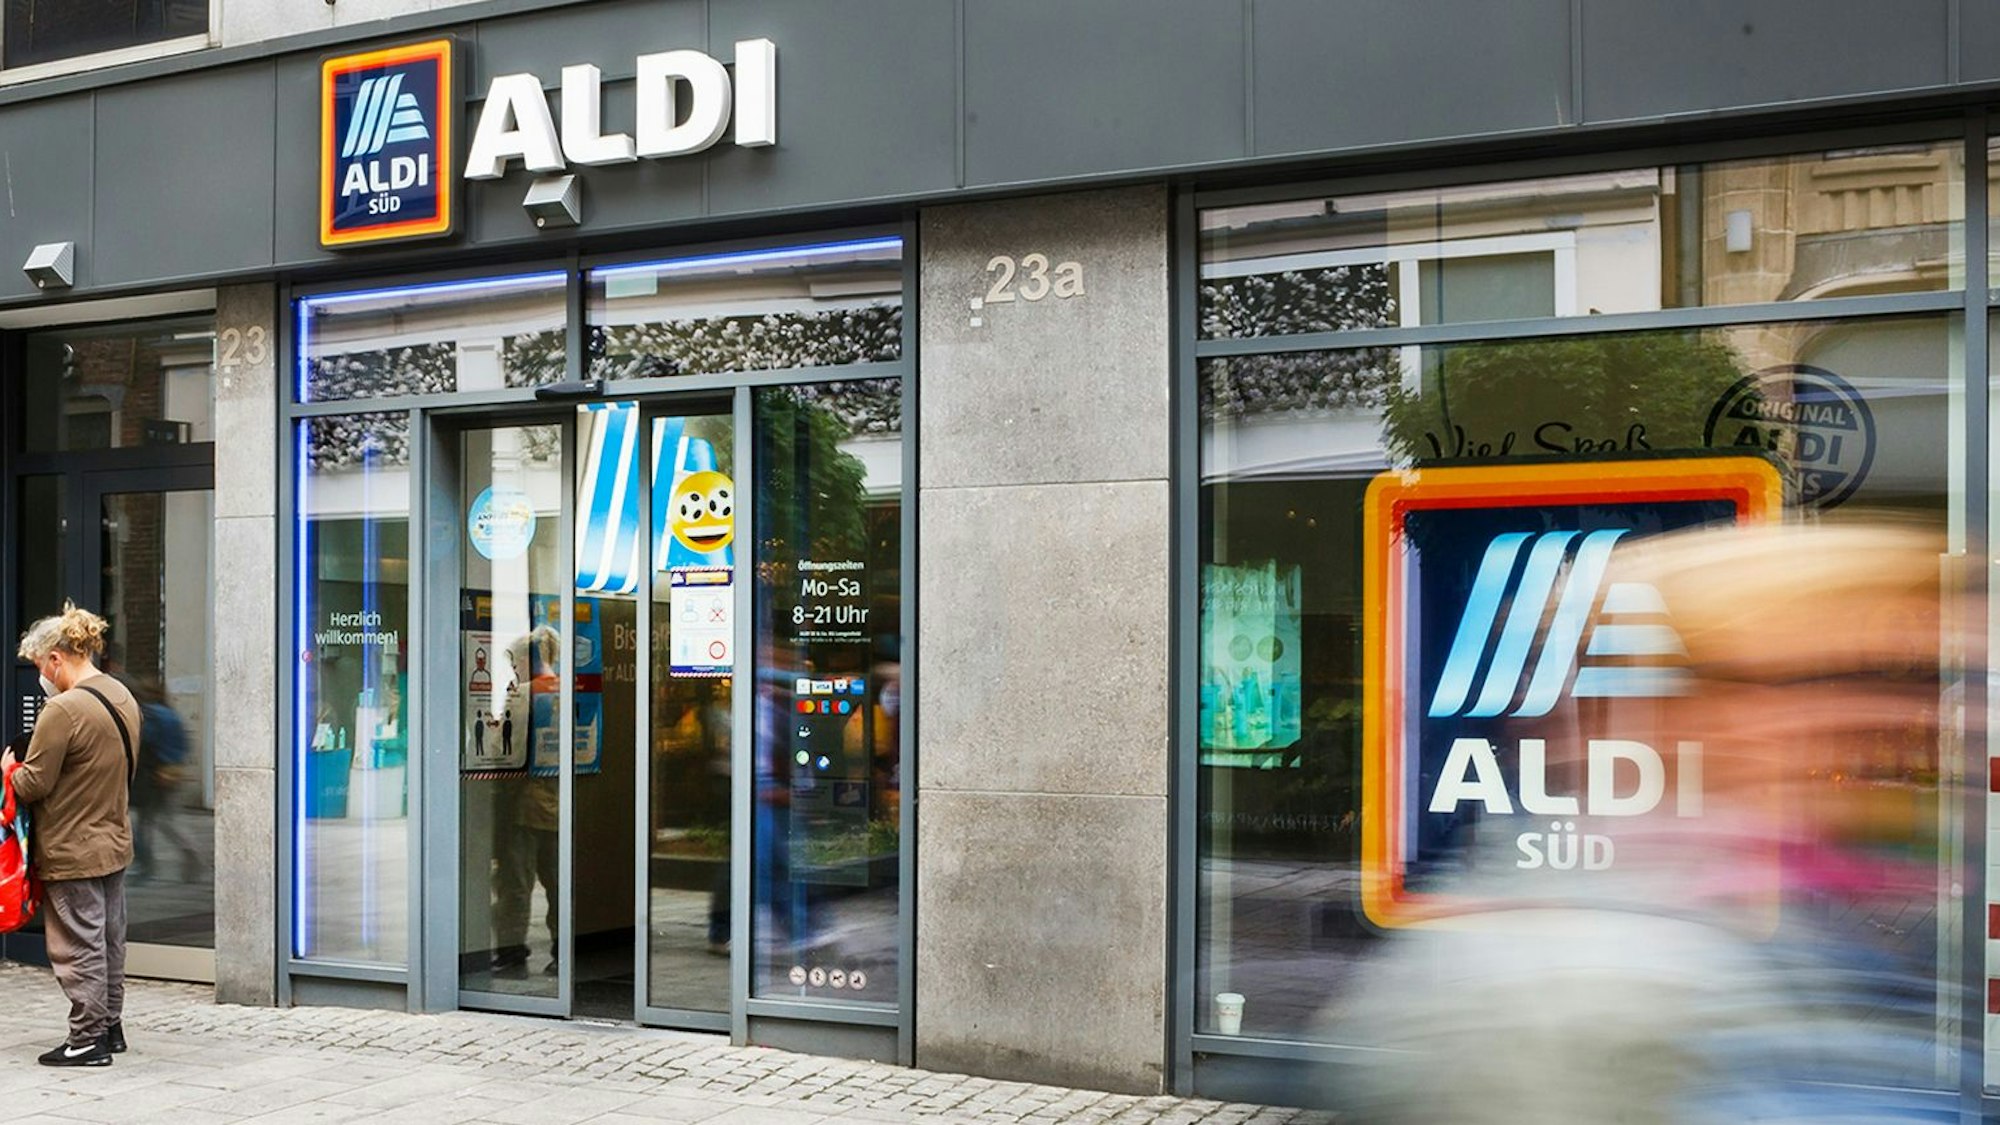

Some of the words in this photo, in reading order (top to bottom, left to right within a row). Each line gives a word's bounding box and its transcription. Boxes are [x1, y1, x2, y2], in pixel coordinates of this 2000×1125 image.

[463, 38, 775, 179] ALDI
[342, 153, 428, 197] ALDI
[369, 193, 401, 215] SÜD
[985, 253, 1085, 303] 23a
[221, 326, 266, 367] 23
[1741, 399, 1847, 425] ORIGINAL
[330, 611, 382, 627] Herzlich
[836, 604, 870, 624] Uhr
[314, 629, 399, 645] willkommen!
[1428, 737, 1704, 818] ALDI
[1516, 820, 1615, 871] SÜD
